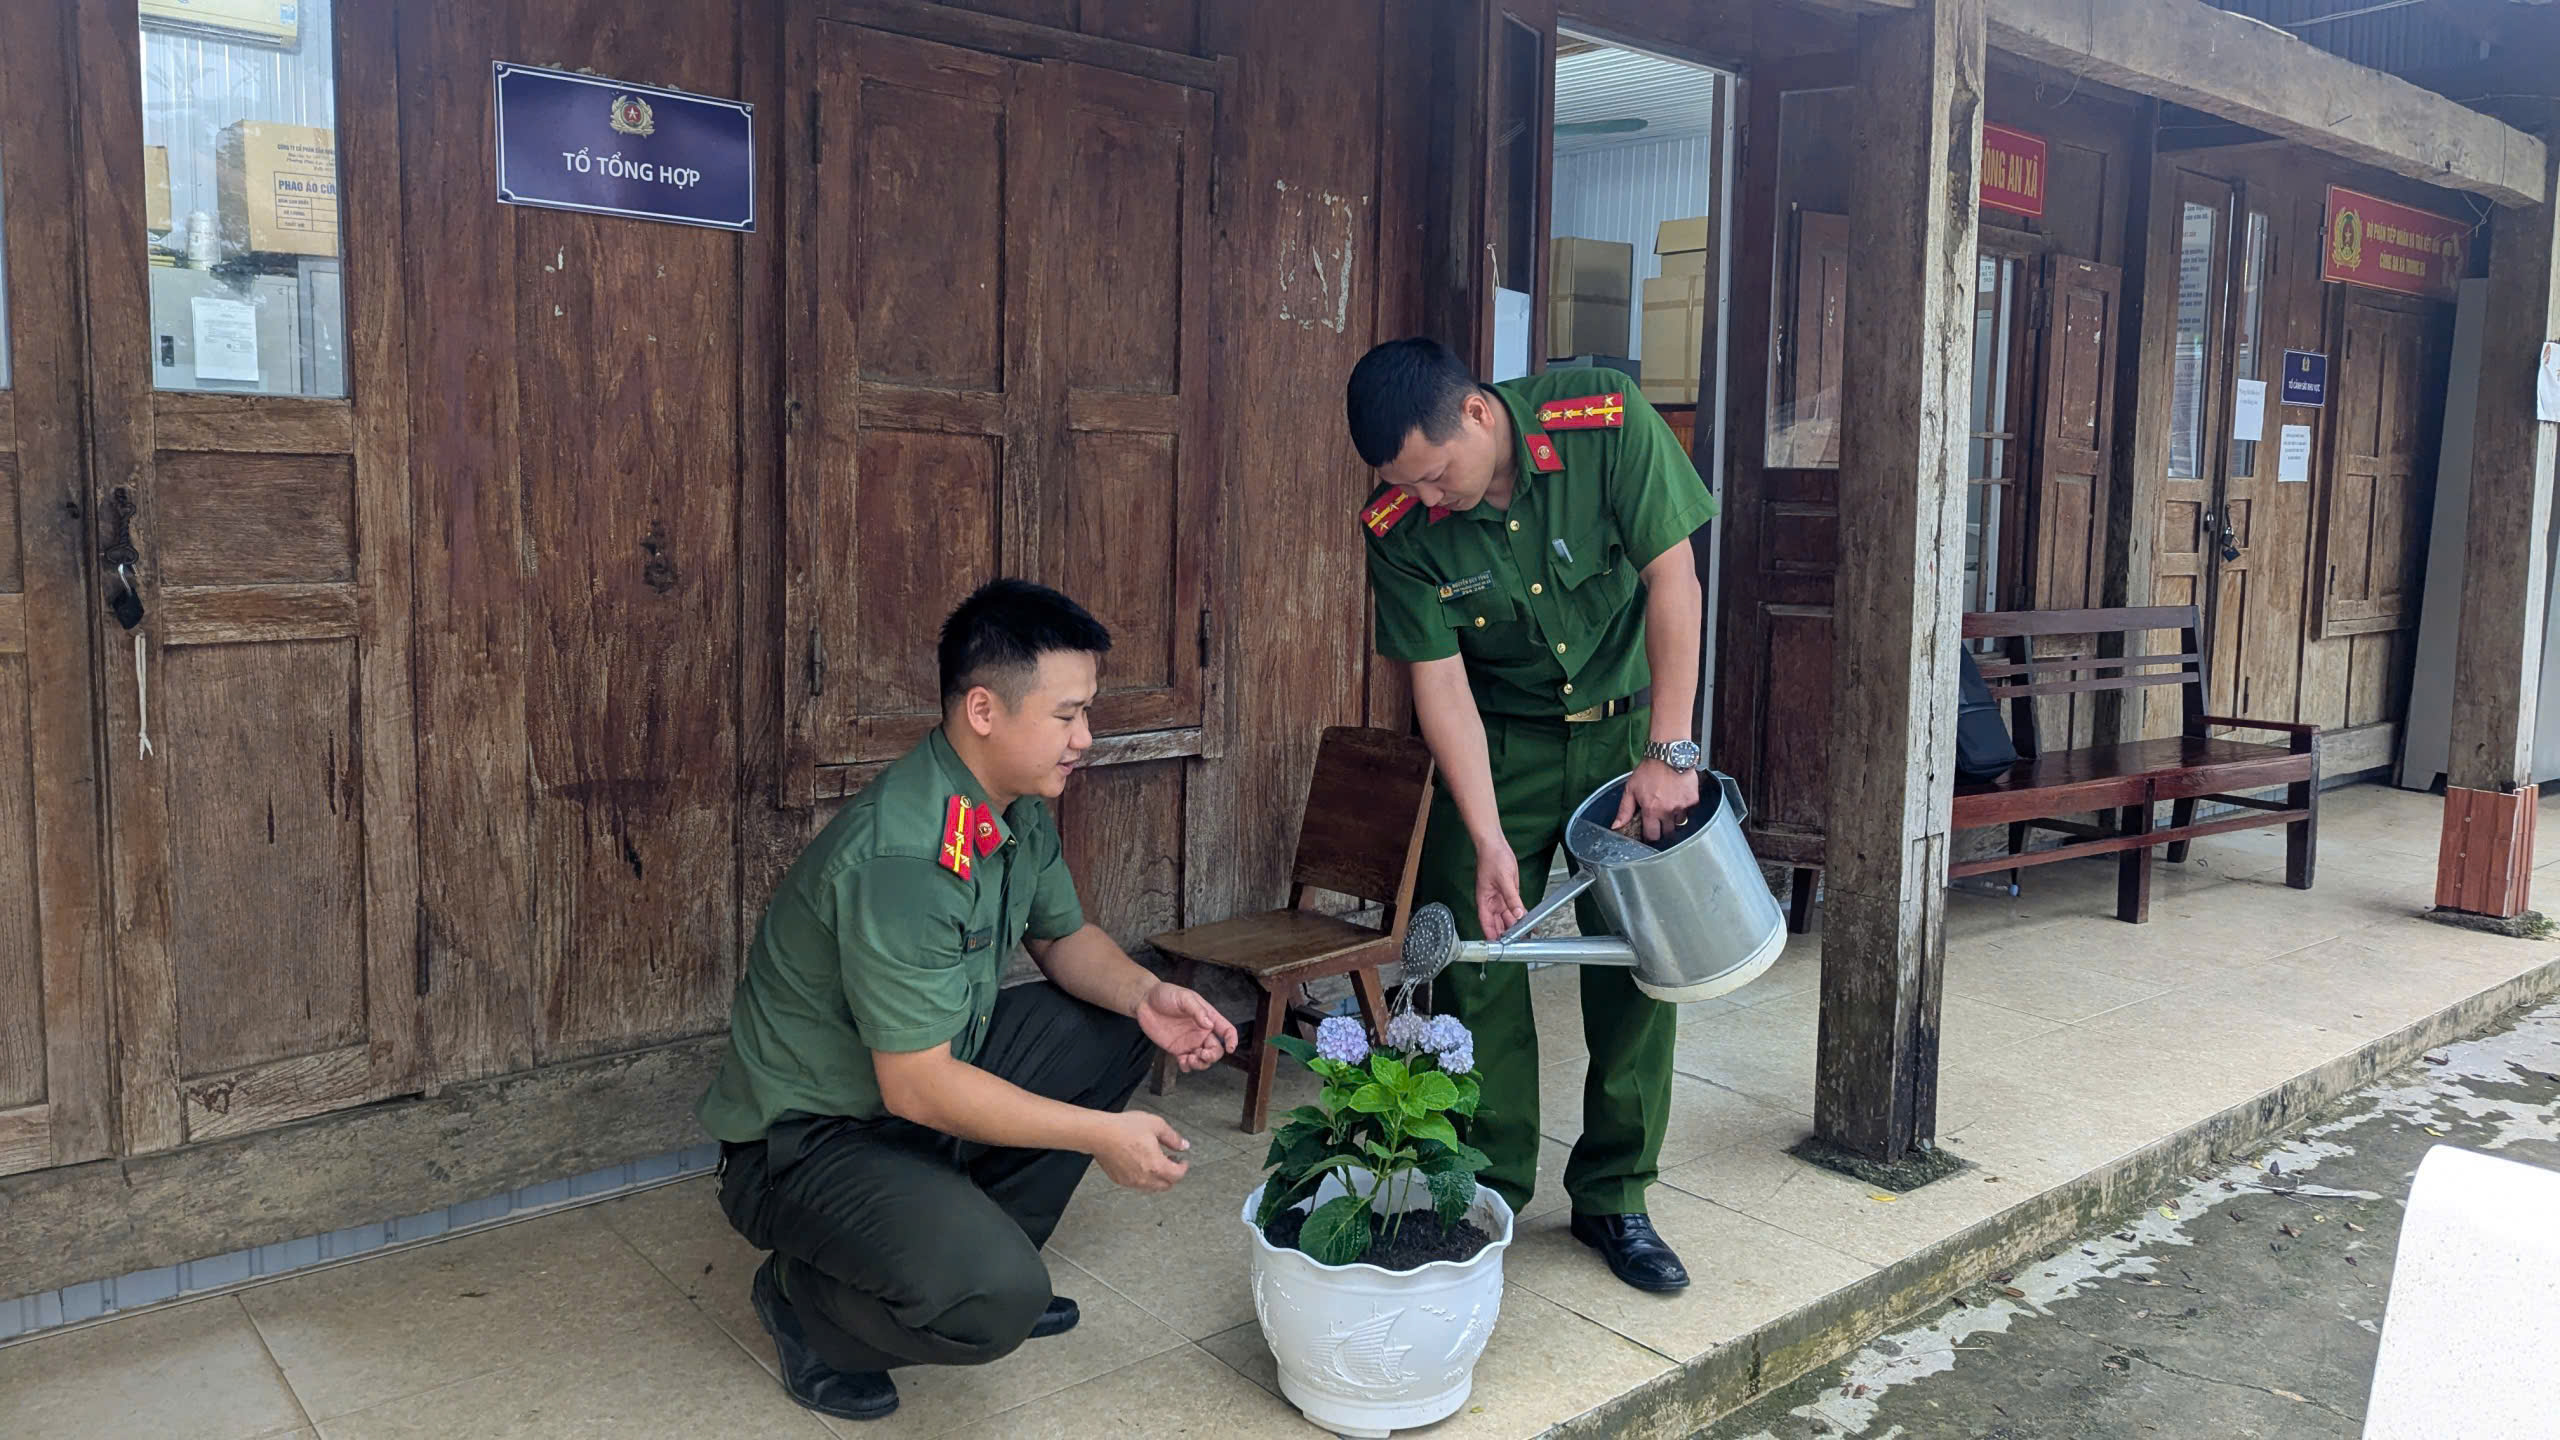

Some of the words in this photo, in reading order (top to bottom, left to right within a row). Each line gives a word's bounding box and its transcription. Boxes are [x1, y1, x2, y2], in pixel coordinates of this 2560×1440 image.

[278, 179, 303, 192] PHAO
[563, 147, 591, 173] TỔ
[596, 152, 653, 181] TỔNG
[659, 166, 700, 189] HỢP
[2007, 154, 2023, 193] AN
[2024, 154, 2038, 198] XÃ
